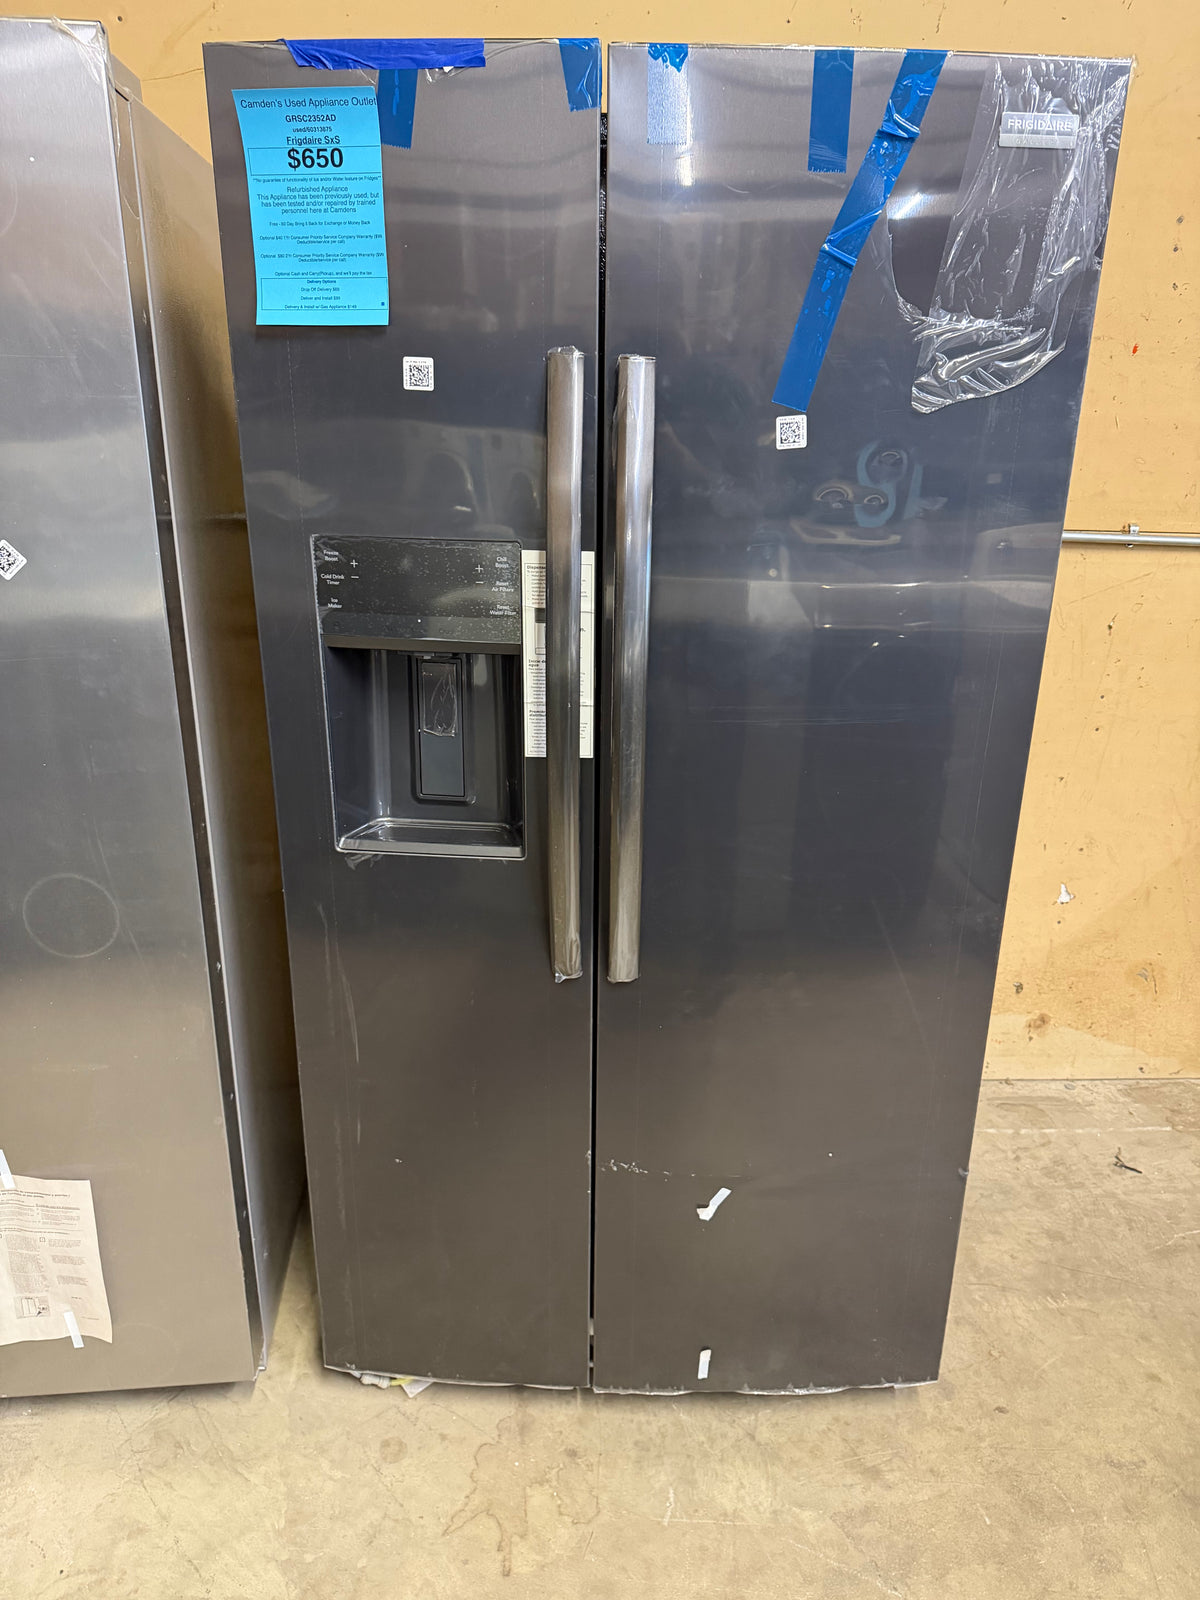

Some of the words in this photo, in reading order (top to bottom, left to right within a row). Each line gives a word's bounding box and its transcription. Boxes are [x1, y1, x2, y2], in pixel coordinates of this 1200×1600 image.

[240, 99, 282, 109] Camden's
[284, 98, 306, 108] Used
[308, 98, 348, 109] Appliance
[351, 96, 376, 106] Outlet
[285, 114, 337, 123] GRSC2352AD
[1007, 119, 1072, 131] FRIGIDAIRE
[286, 135, 322, 146] Frigdaire
[324, 135, 341, 145] SxS
[287, 147, 344, 171] $650
[321, 185, 348, 193] Appliance
[270, 193, 297, 201] Appliance
[324, 192, 352, 200] previously
